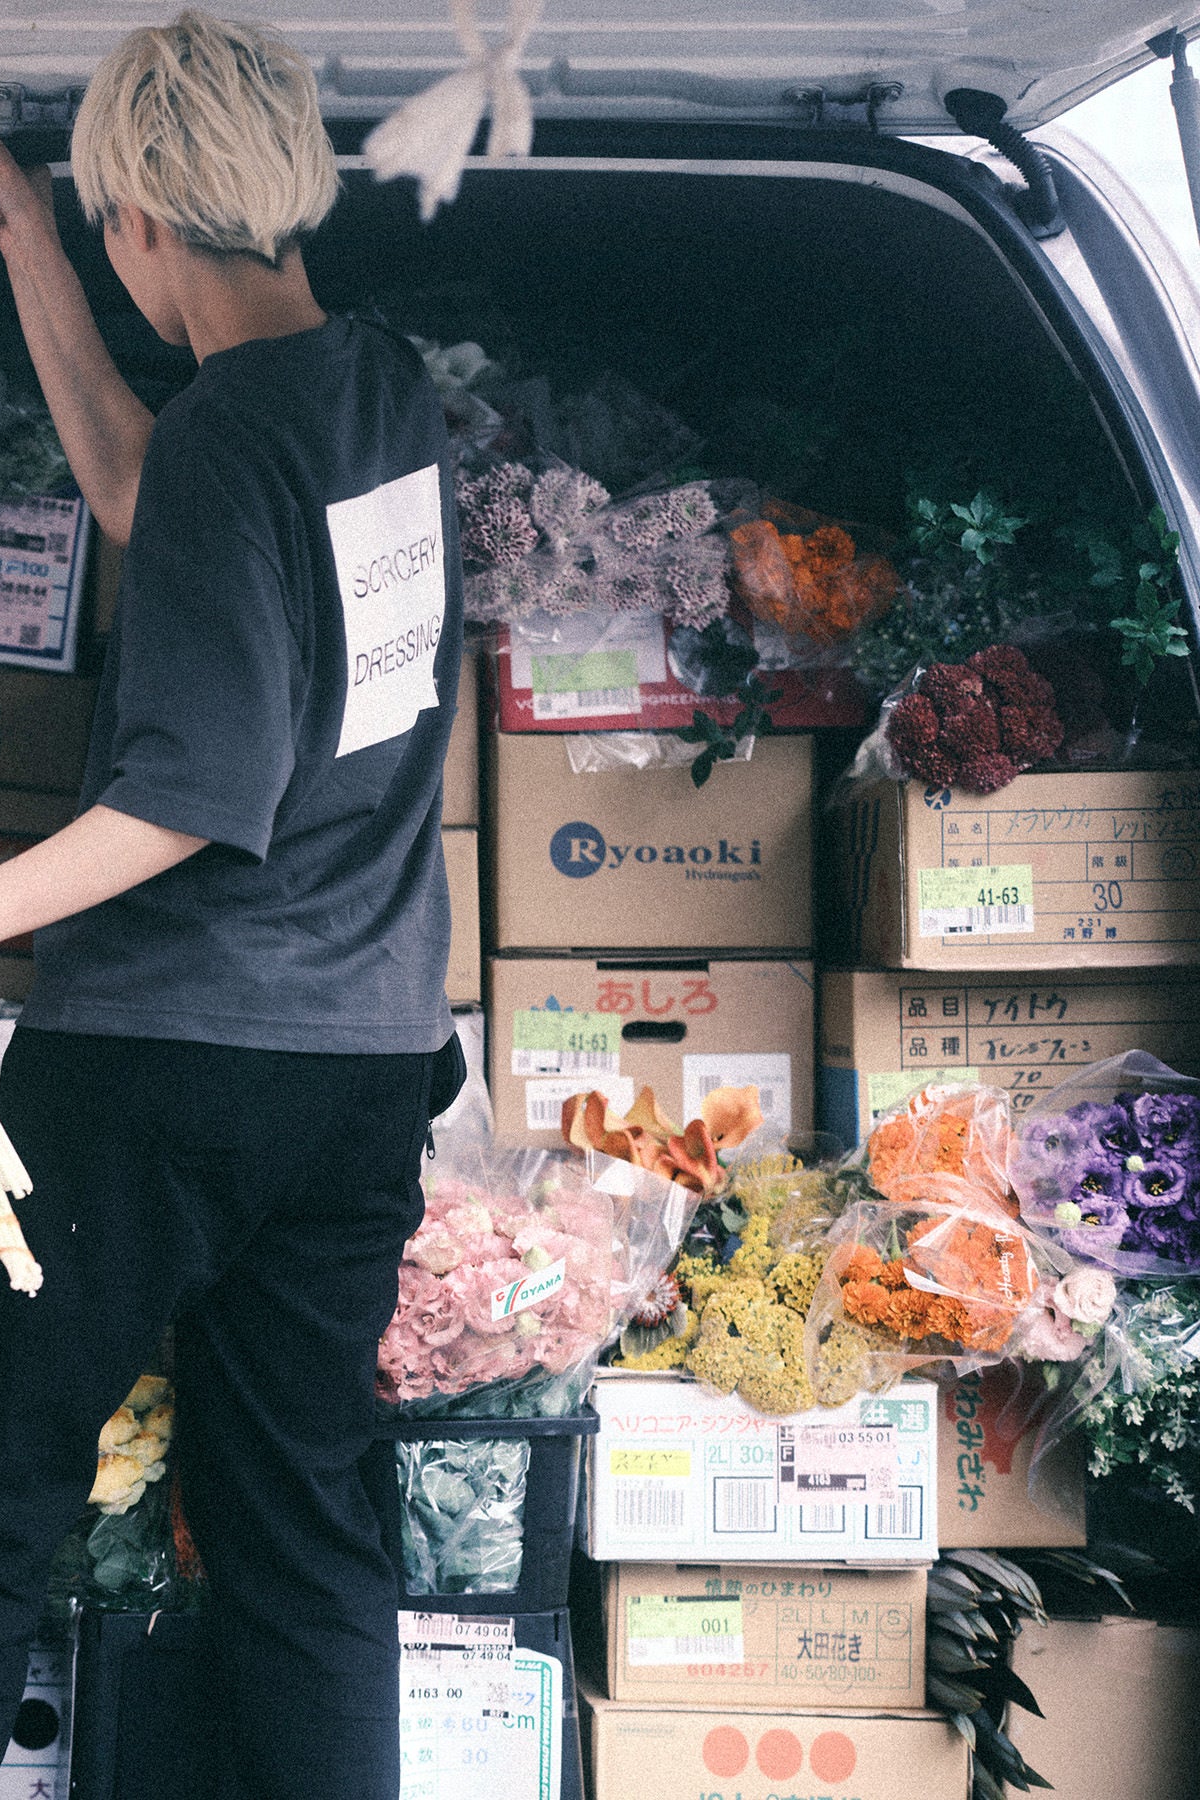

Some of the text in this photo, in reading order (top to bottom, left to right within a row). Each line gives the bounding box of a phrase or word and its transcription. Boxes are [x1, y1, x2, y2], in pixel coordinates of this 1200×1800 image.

[353, 531, 438, 599] SORCERY
[353, 614, 441, 687] DRESSING
[947, 822, 983, 836] 品名
[566, 836, 762, 870] Ryoaoki
[977, 886, 1020, 906] 41-63
[1092, 880, 1123, 912] 30
[595, 978, 719, 1015] あしろ
[908, 996, 960, 1018] 品目
[567, 1032, 608, 1051] 41-63
[909, 1036, 961, 1057] 品種
[1010, 1070, 1043, 1089] 70
[519, 1273, 562, 1301] OYAMA
[707, 1444, 729, 1464] 2L
[781, 1607, 806, 1624] 2L
[821, 1607, 833, 1624] L
[852, 1608, 870, 1625] M
[886, 1608, 901, 1626] S
[701, 1617, 730, 1635] 001
[796, 1628, 863, 1663] 大田花き
[408, 1687, 463, 1699] 4163 00
